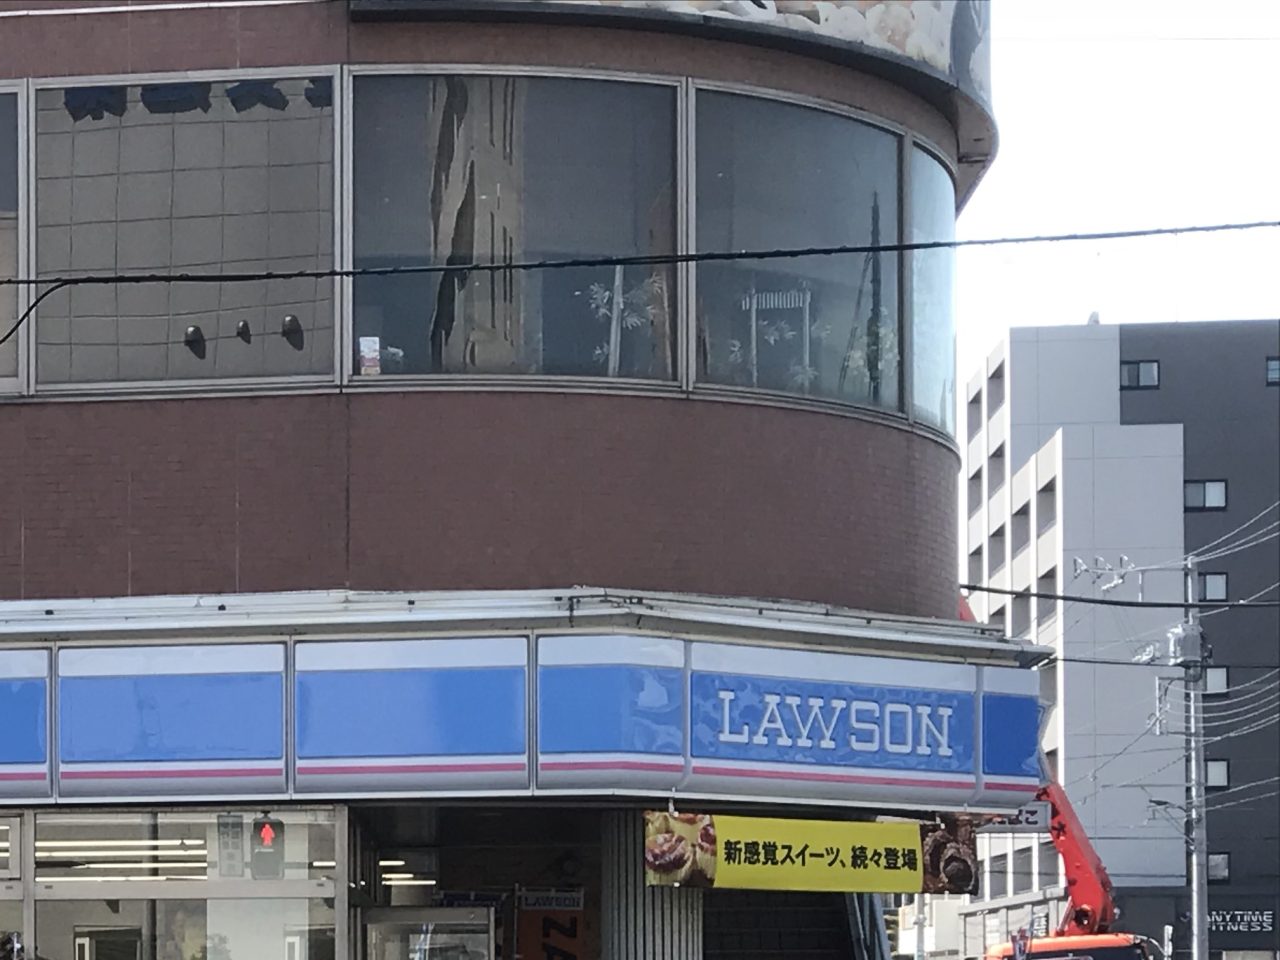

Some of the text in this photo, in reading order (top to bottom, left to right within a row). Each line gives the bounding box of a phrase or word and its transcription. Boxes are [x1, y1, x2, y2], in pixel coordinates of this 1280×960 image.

[717, 689, 954, 758] LAWSON
[723, 839, 919, 872] 新感覚スイーツ、続々登場
